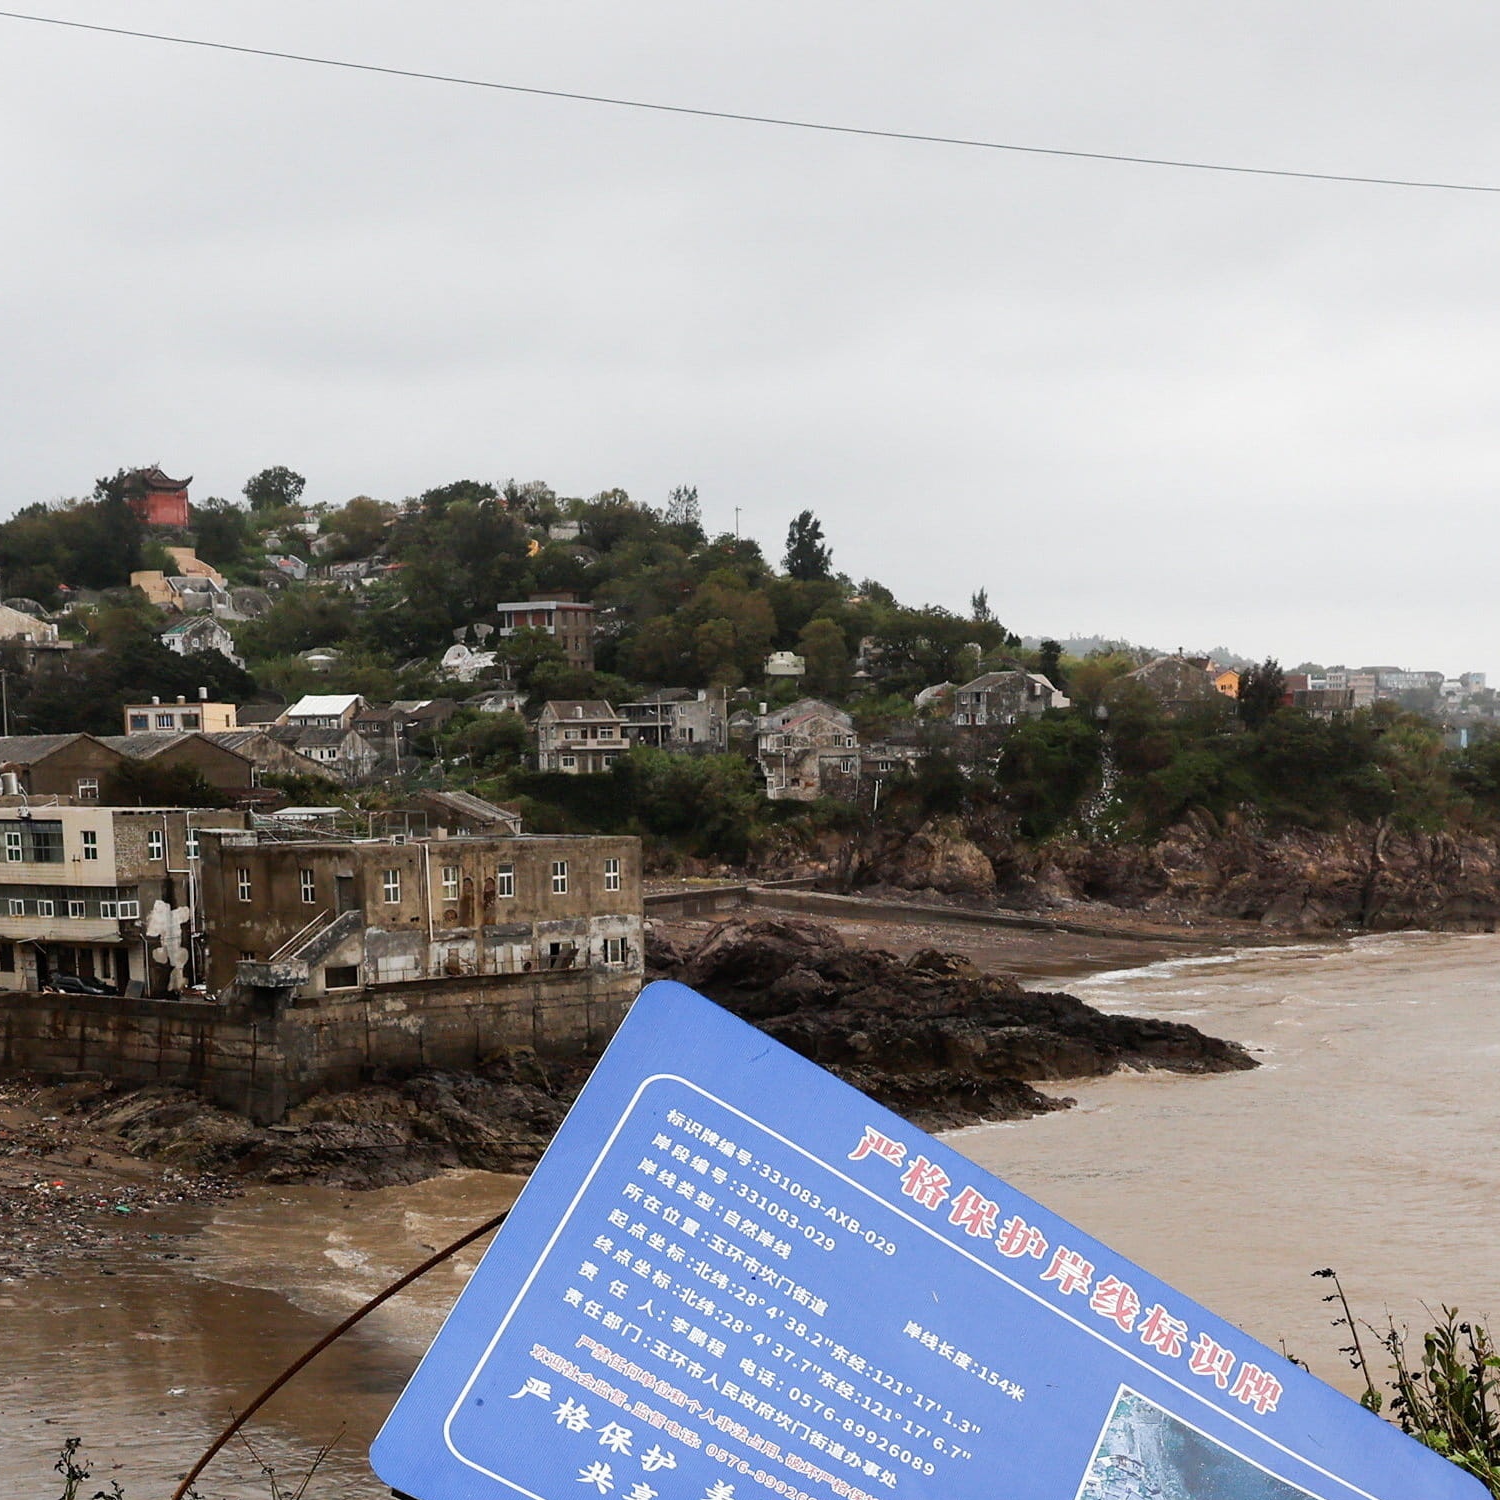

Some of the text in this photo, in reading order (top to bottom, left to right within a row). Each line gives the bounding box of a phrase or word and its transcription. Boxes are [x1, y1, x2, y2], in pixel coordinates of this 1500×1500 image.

[637, 1157, 793, 1260] 岸线类型:自然岸线
[651, 1132, 836, 1252] 岸段编号:331083-029
[666, 1108, 896, 1256] 标识牌编号:331083-AXB-029
[622, 1182, 829, 1317] 所在位置:玉环市坎门街道
[848, 1125, 1284, 1415] 严格保护岸线标识牌
[508, 1376, 678, 1472] 严格保护
[563, 1287, 898, 1488] 责任部门:玉环市人民政府坎门街道办事处
[903, 1319, 1027, 1402] 岸线长度:154米
